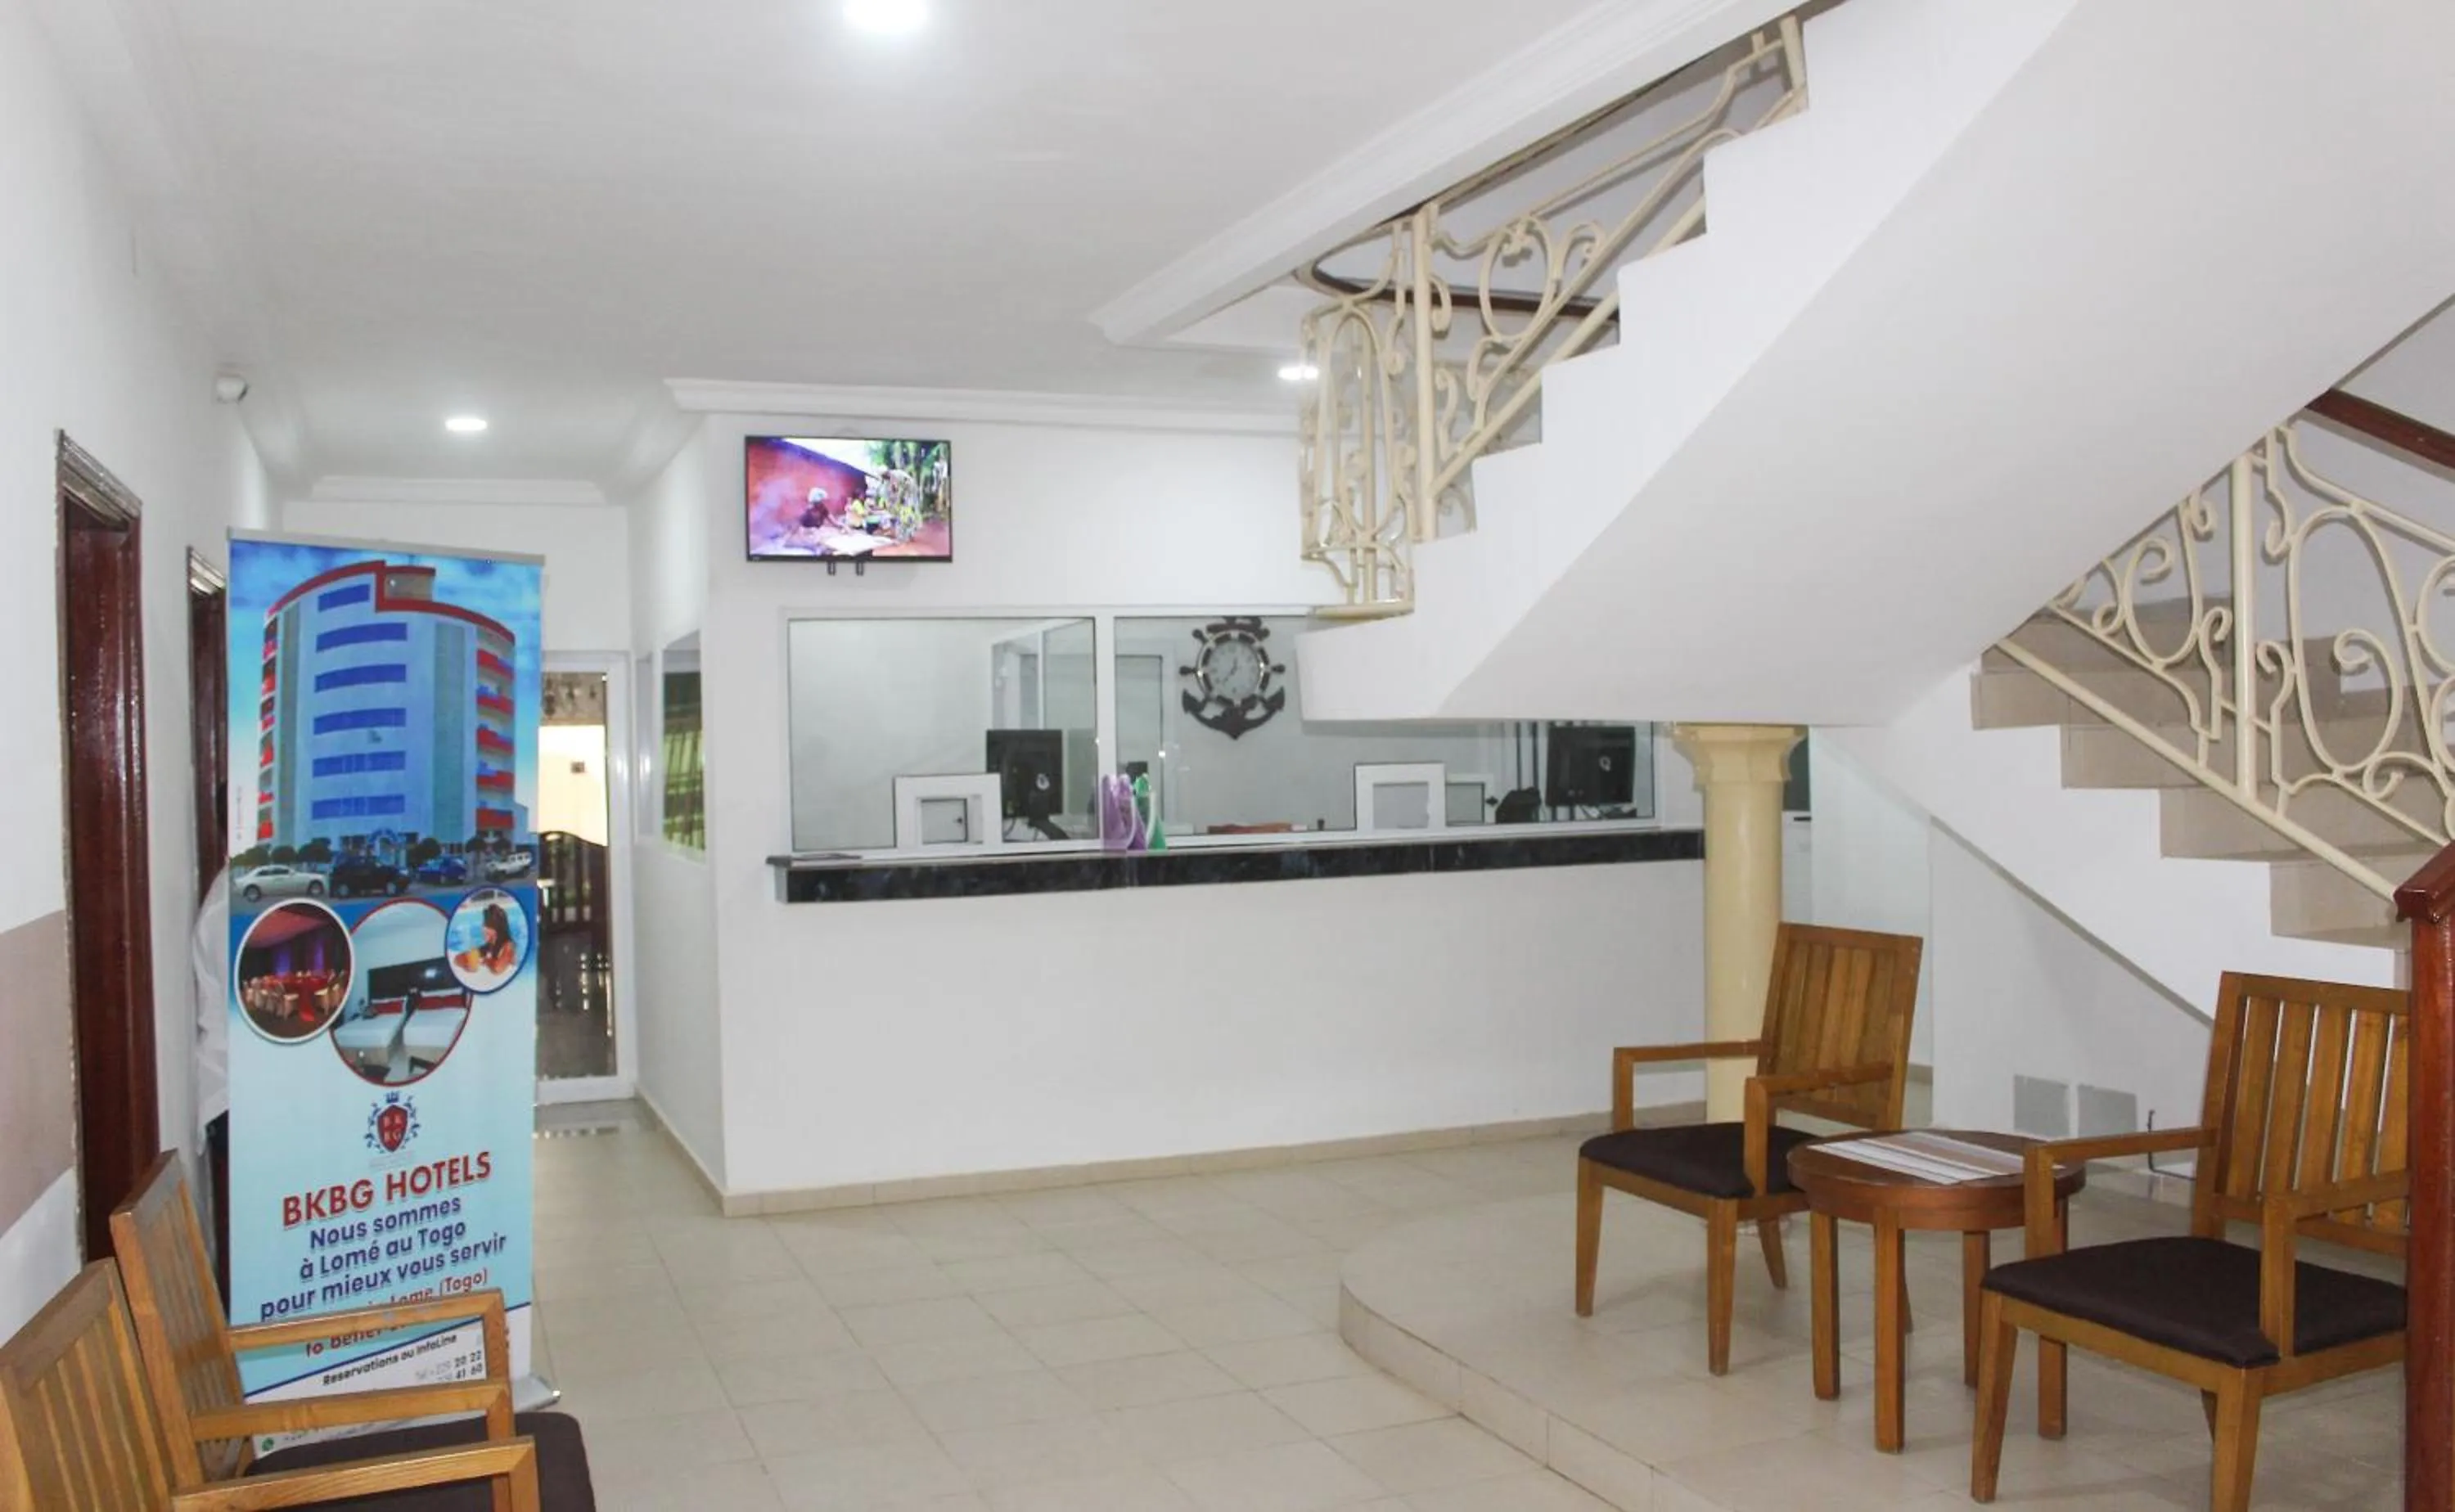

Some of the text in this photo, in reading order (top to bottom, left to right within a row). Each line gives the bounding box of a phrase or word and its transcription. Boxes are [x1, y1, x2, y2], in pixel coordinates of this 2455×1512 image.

[283, 1151, 491, 1226] BKBG HOTELS
[300, 1221, 466, 1280] à Lomé au Togo
[310, 1197, 461, 1249] Nous sommes
[260, 1232, 507, 1322] pour mieux vous servir
